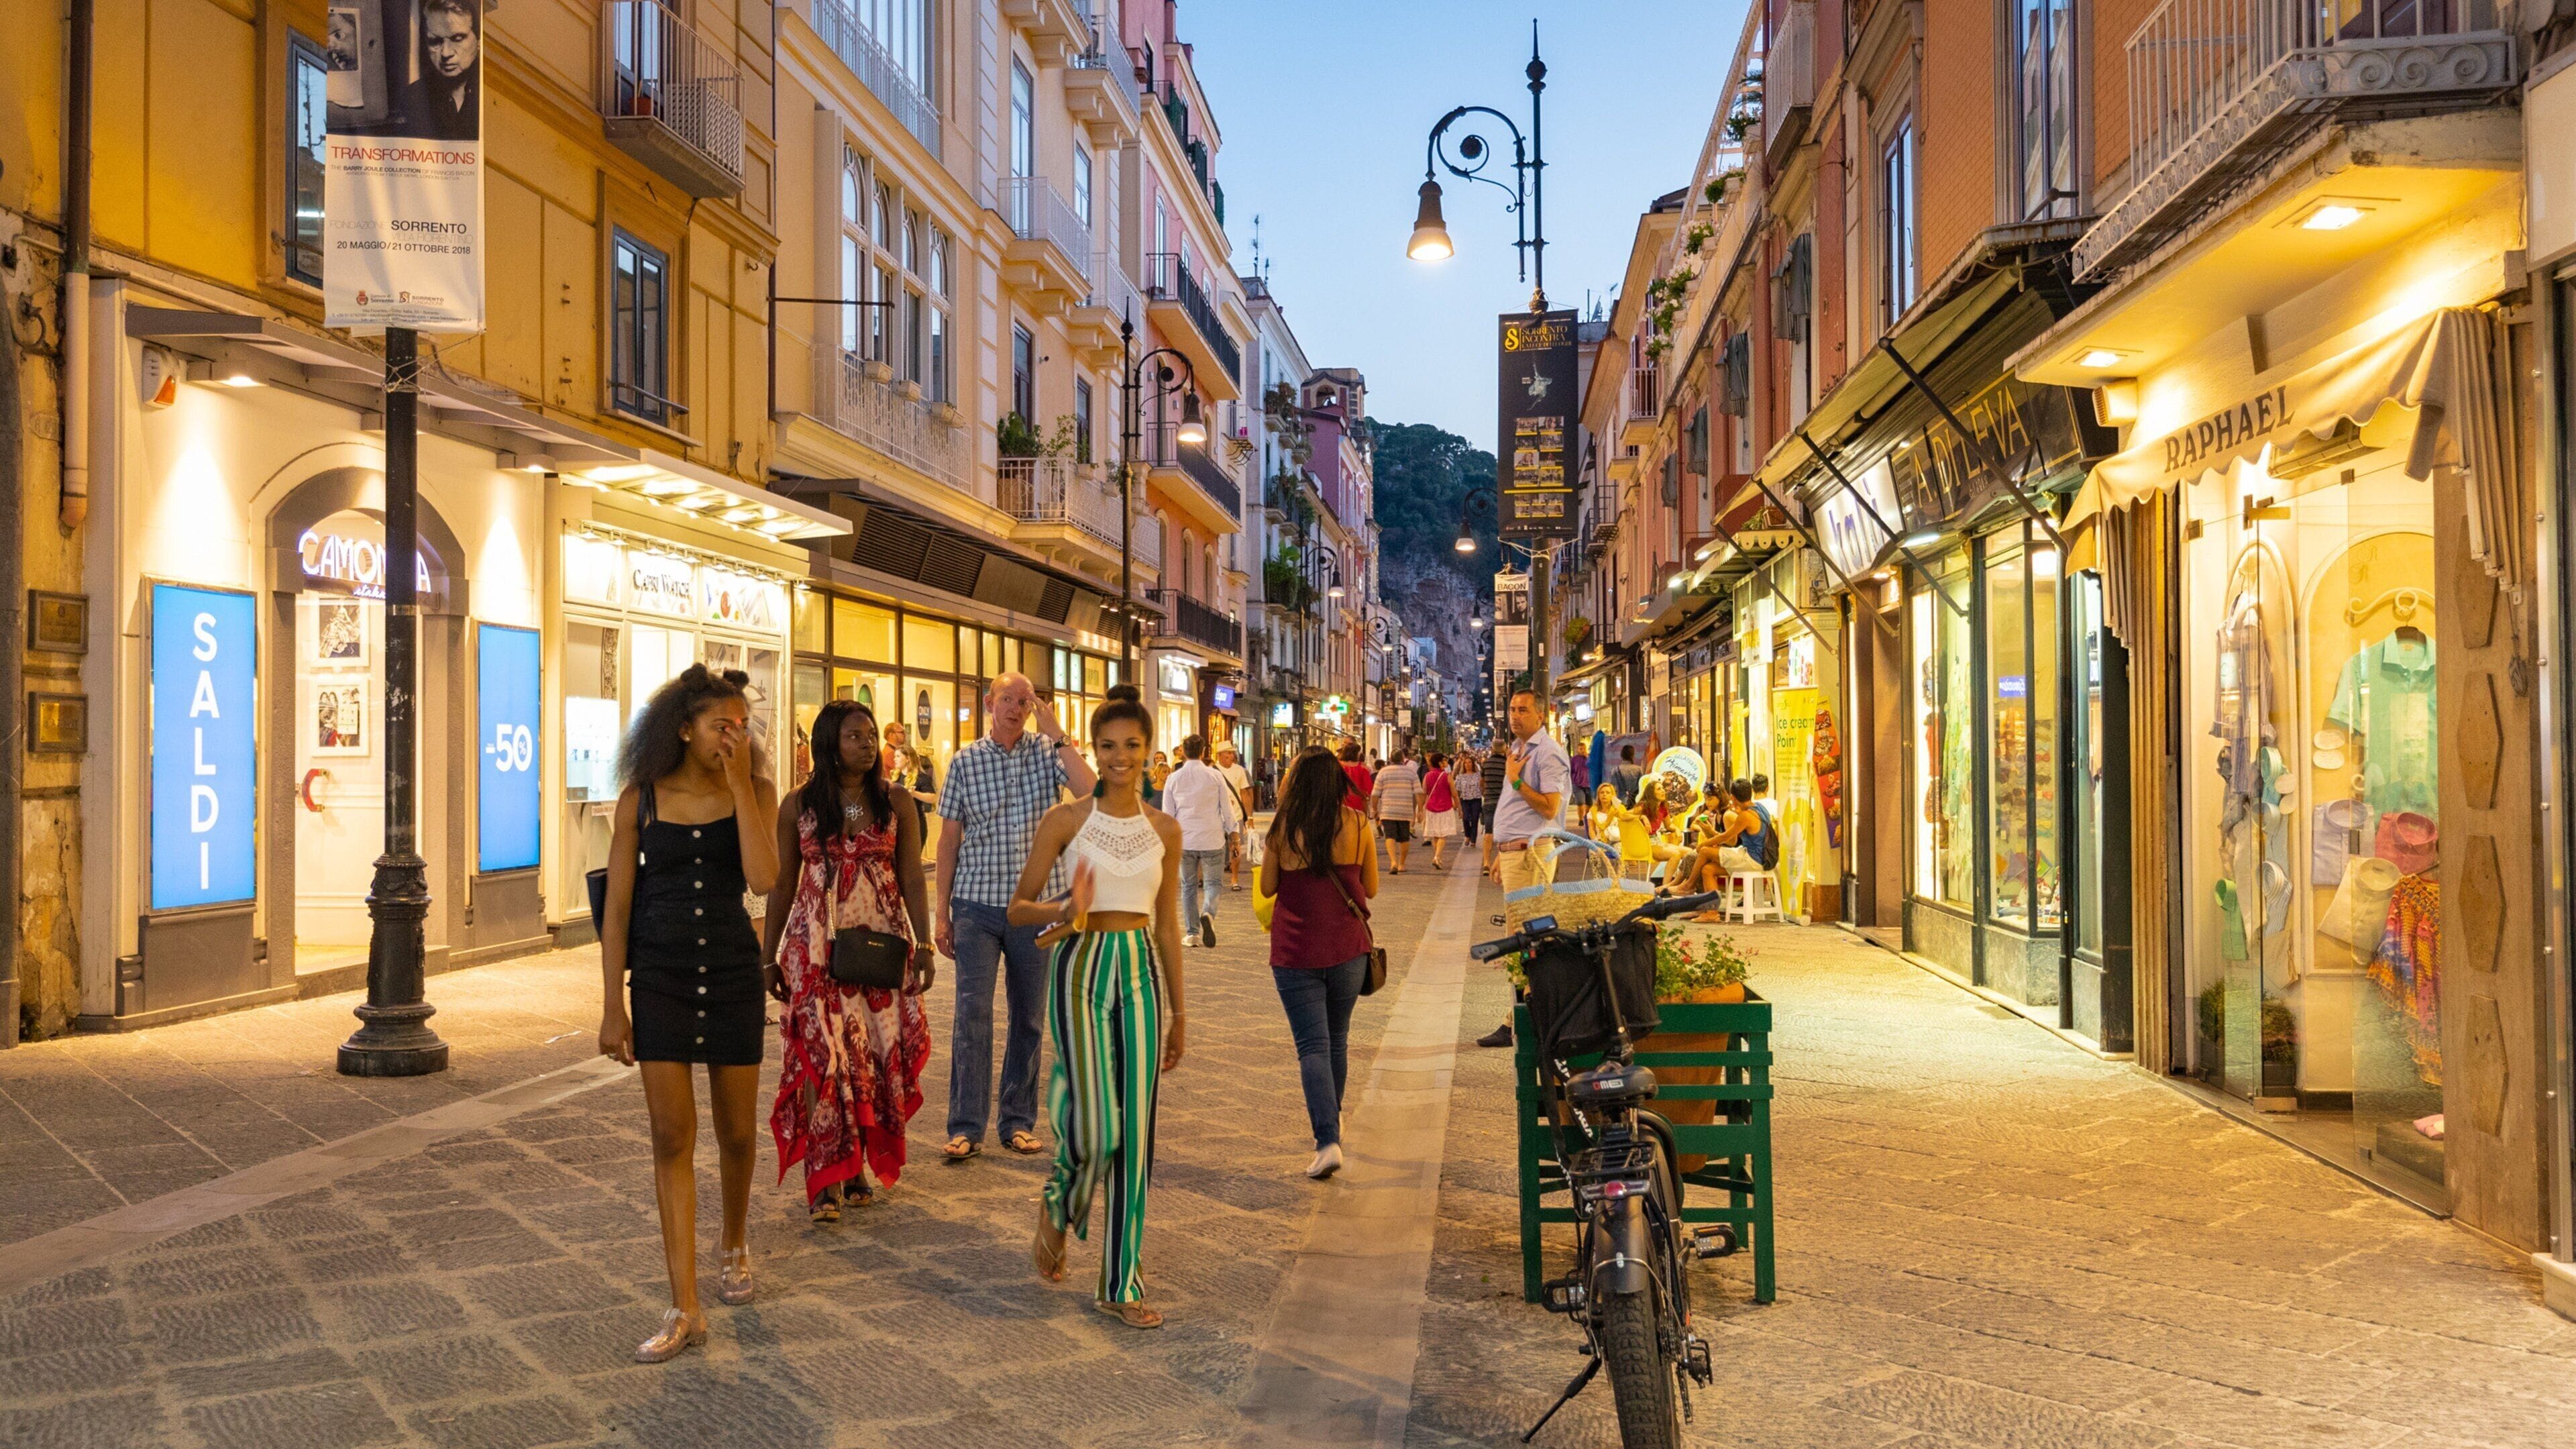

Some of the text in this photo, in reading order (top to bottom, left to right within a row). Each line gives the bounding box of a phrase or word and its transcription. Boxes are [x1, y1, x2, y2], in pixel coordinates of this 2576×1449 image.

[331, 146, 476, 165] TRANSFORMATIONS
[329, 219, 468, 235] FONDAZIONE SORRENTO
[337, 241, 347, 250] 20
[405, 244, 449, 254] OTTOBRE
[451, 246, 472, 254] 2018
[1521, 325, 1568, 335] SORRENTO
[1521, 333, 1565, 343] INCONTRA
[2164, 384, 2296, 474] RAPHAEL
[1932, 427, 1962, 494] DI
[1960, 385, 2031, 480] LEVA
[1497, 582, 1526, 590] BACON
[918, 706, 930, 716] ONLY
[1776, 715, 1815, 729] Ice cream
[189, 611, 221, 890] SALDI
[1665, 756, 1699, 782] Primavera
